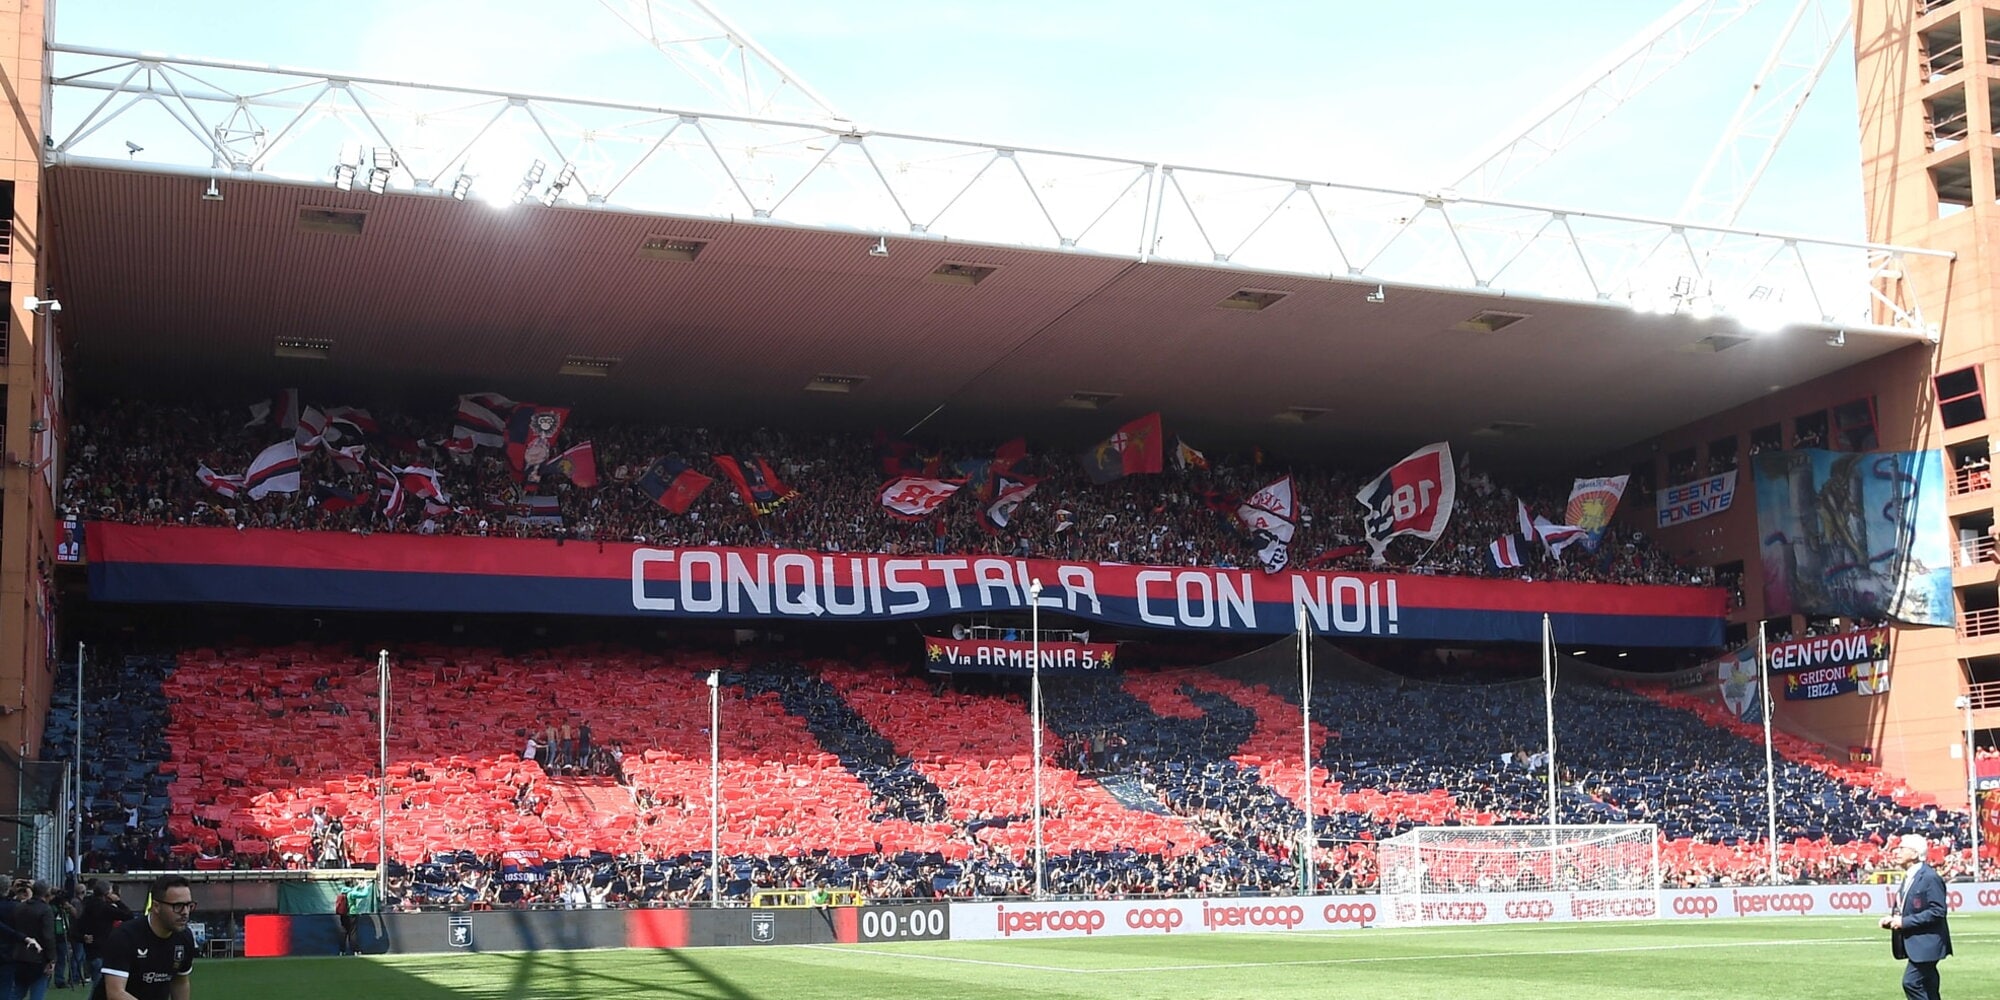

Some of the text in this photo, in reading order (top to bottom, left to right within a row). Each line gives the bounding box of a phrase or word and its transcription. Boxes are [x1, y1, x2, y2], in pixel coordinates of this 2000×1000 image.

[1668, 477, 1725, 504] SESTRI
[1660, 492, 1731, 525] PONENTE
[632, 548, 1399, 635] CONQUISTALA CON NOI!
[977, 646, 1077, 669] ARMENIA
[1799, 666, 1846, 685] GRIFONI
[1807, 682, 1839, 699] IBIZA
[862, 909, 944, 938] 00:00
[997, 904, 1105, 937] ipercoop
[1125, 908, 1183, 933] coop
[1203, 900, 1304, 931] ipercoop
[1323, 903, 1376, 928] coop
[1504, 899, 1554, 921] coop
[1672, 894, 1718, 918] coop
[1732, 889, 1814, 917] ipercoop
[1829, 891, 1871, 913] coop
